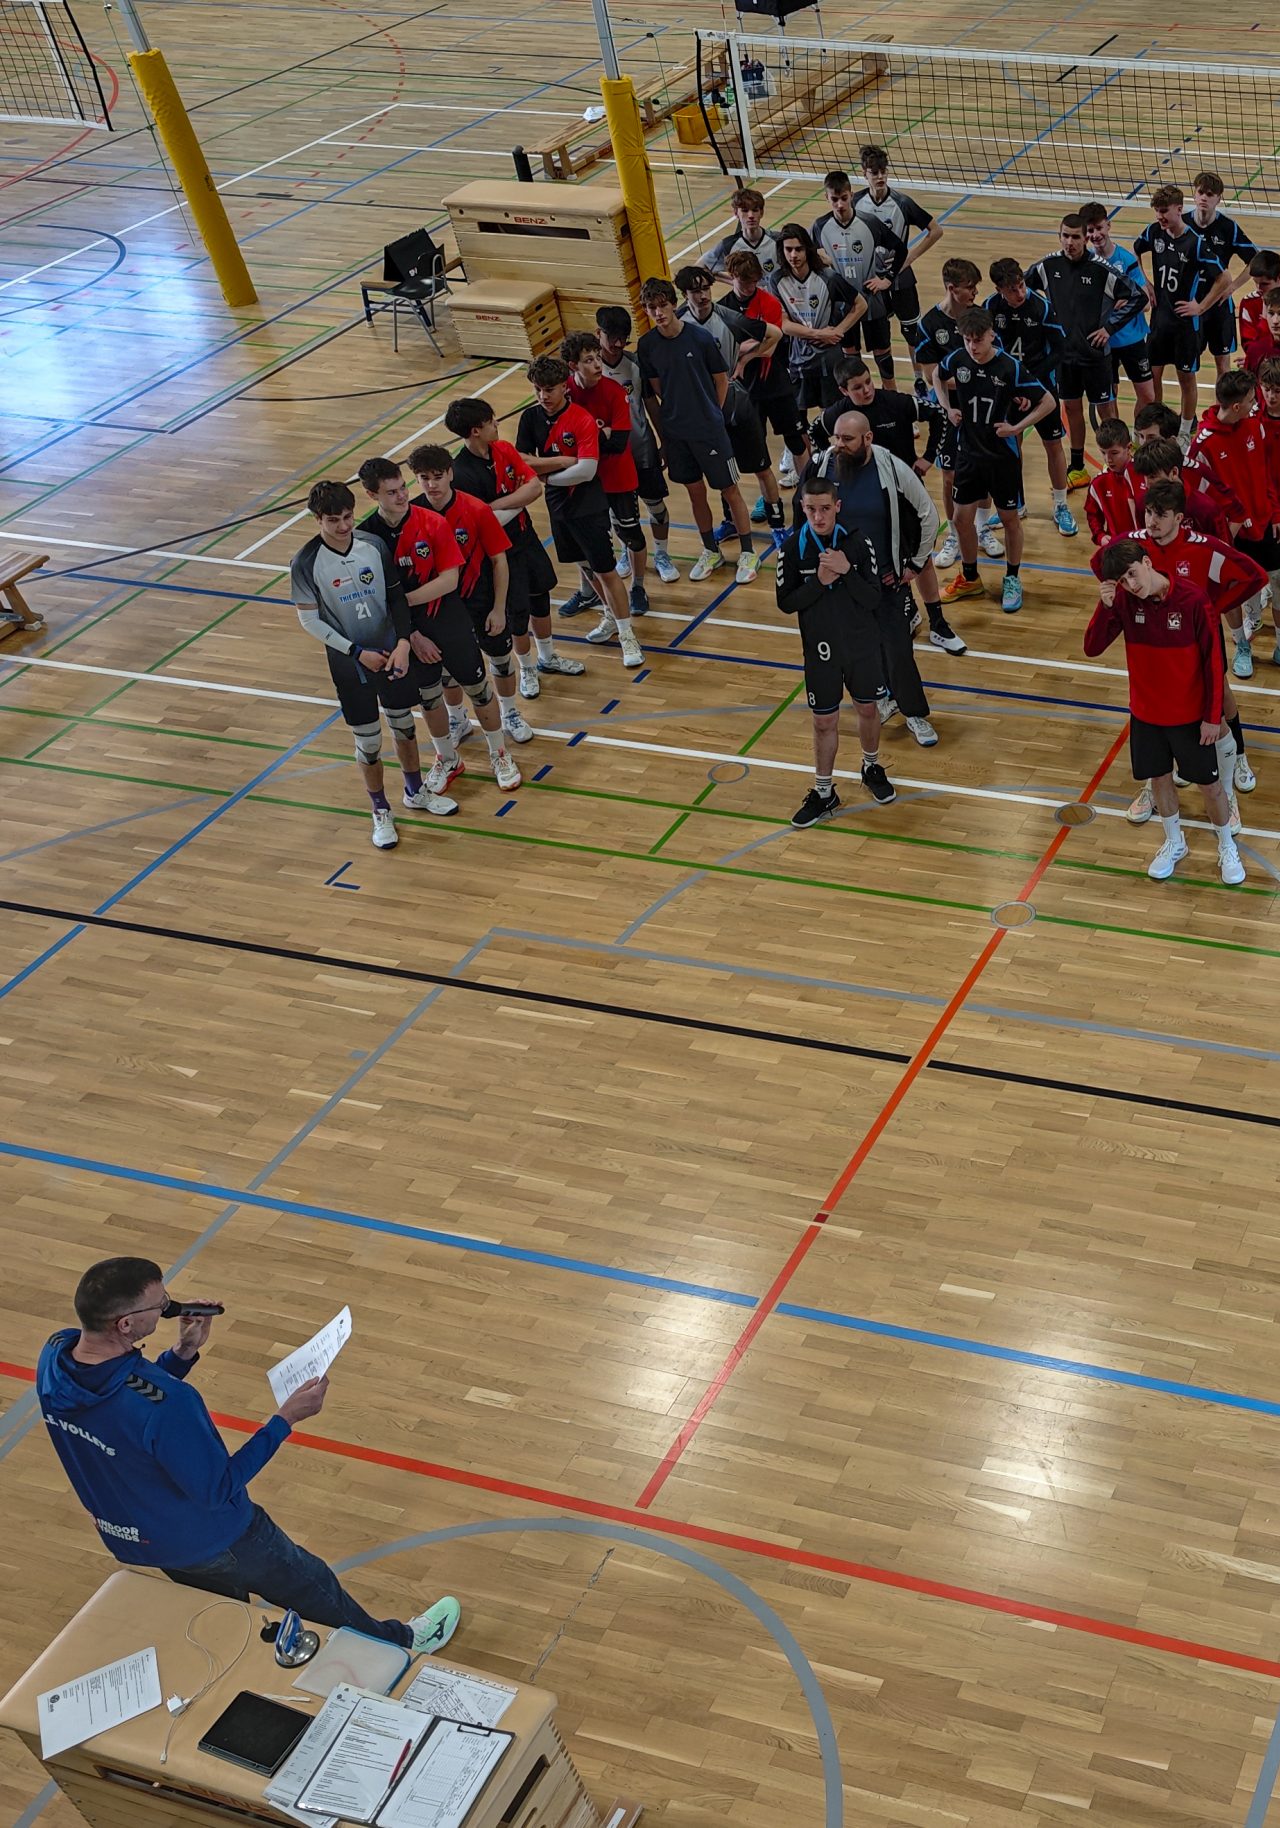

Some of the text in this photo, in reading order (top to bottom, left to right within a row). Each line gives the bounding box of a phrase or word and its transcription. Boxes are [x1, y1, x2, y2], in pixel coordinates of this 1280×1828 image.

[513, 216, 546, 225] BENZ
[1081, 276, 1092, 285] TK
[1158, 265, 1179, 293] 15
[1010, 336, 1025, 361] 4
[968, 396, 994, 424] 17
[940, 454, 951, 467] 12
[355, 602, 372, 620] 21
[817, 641, 831, 661] 9
[808, 692, 816, 706] 8
[58, 1419, 117, 1457] VOLLEYS
[96, 1517, 140, 1536] INDOOR
